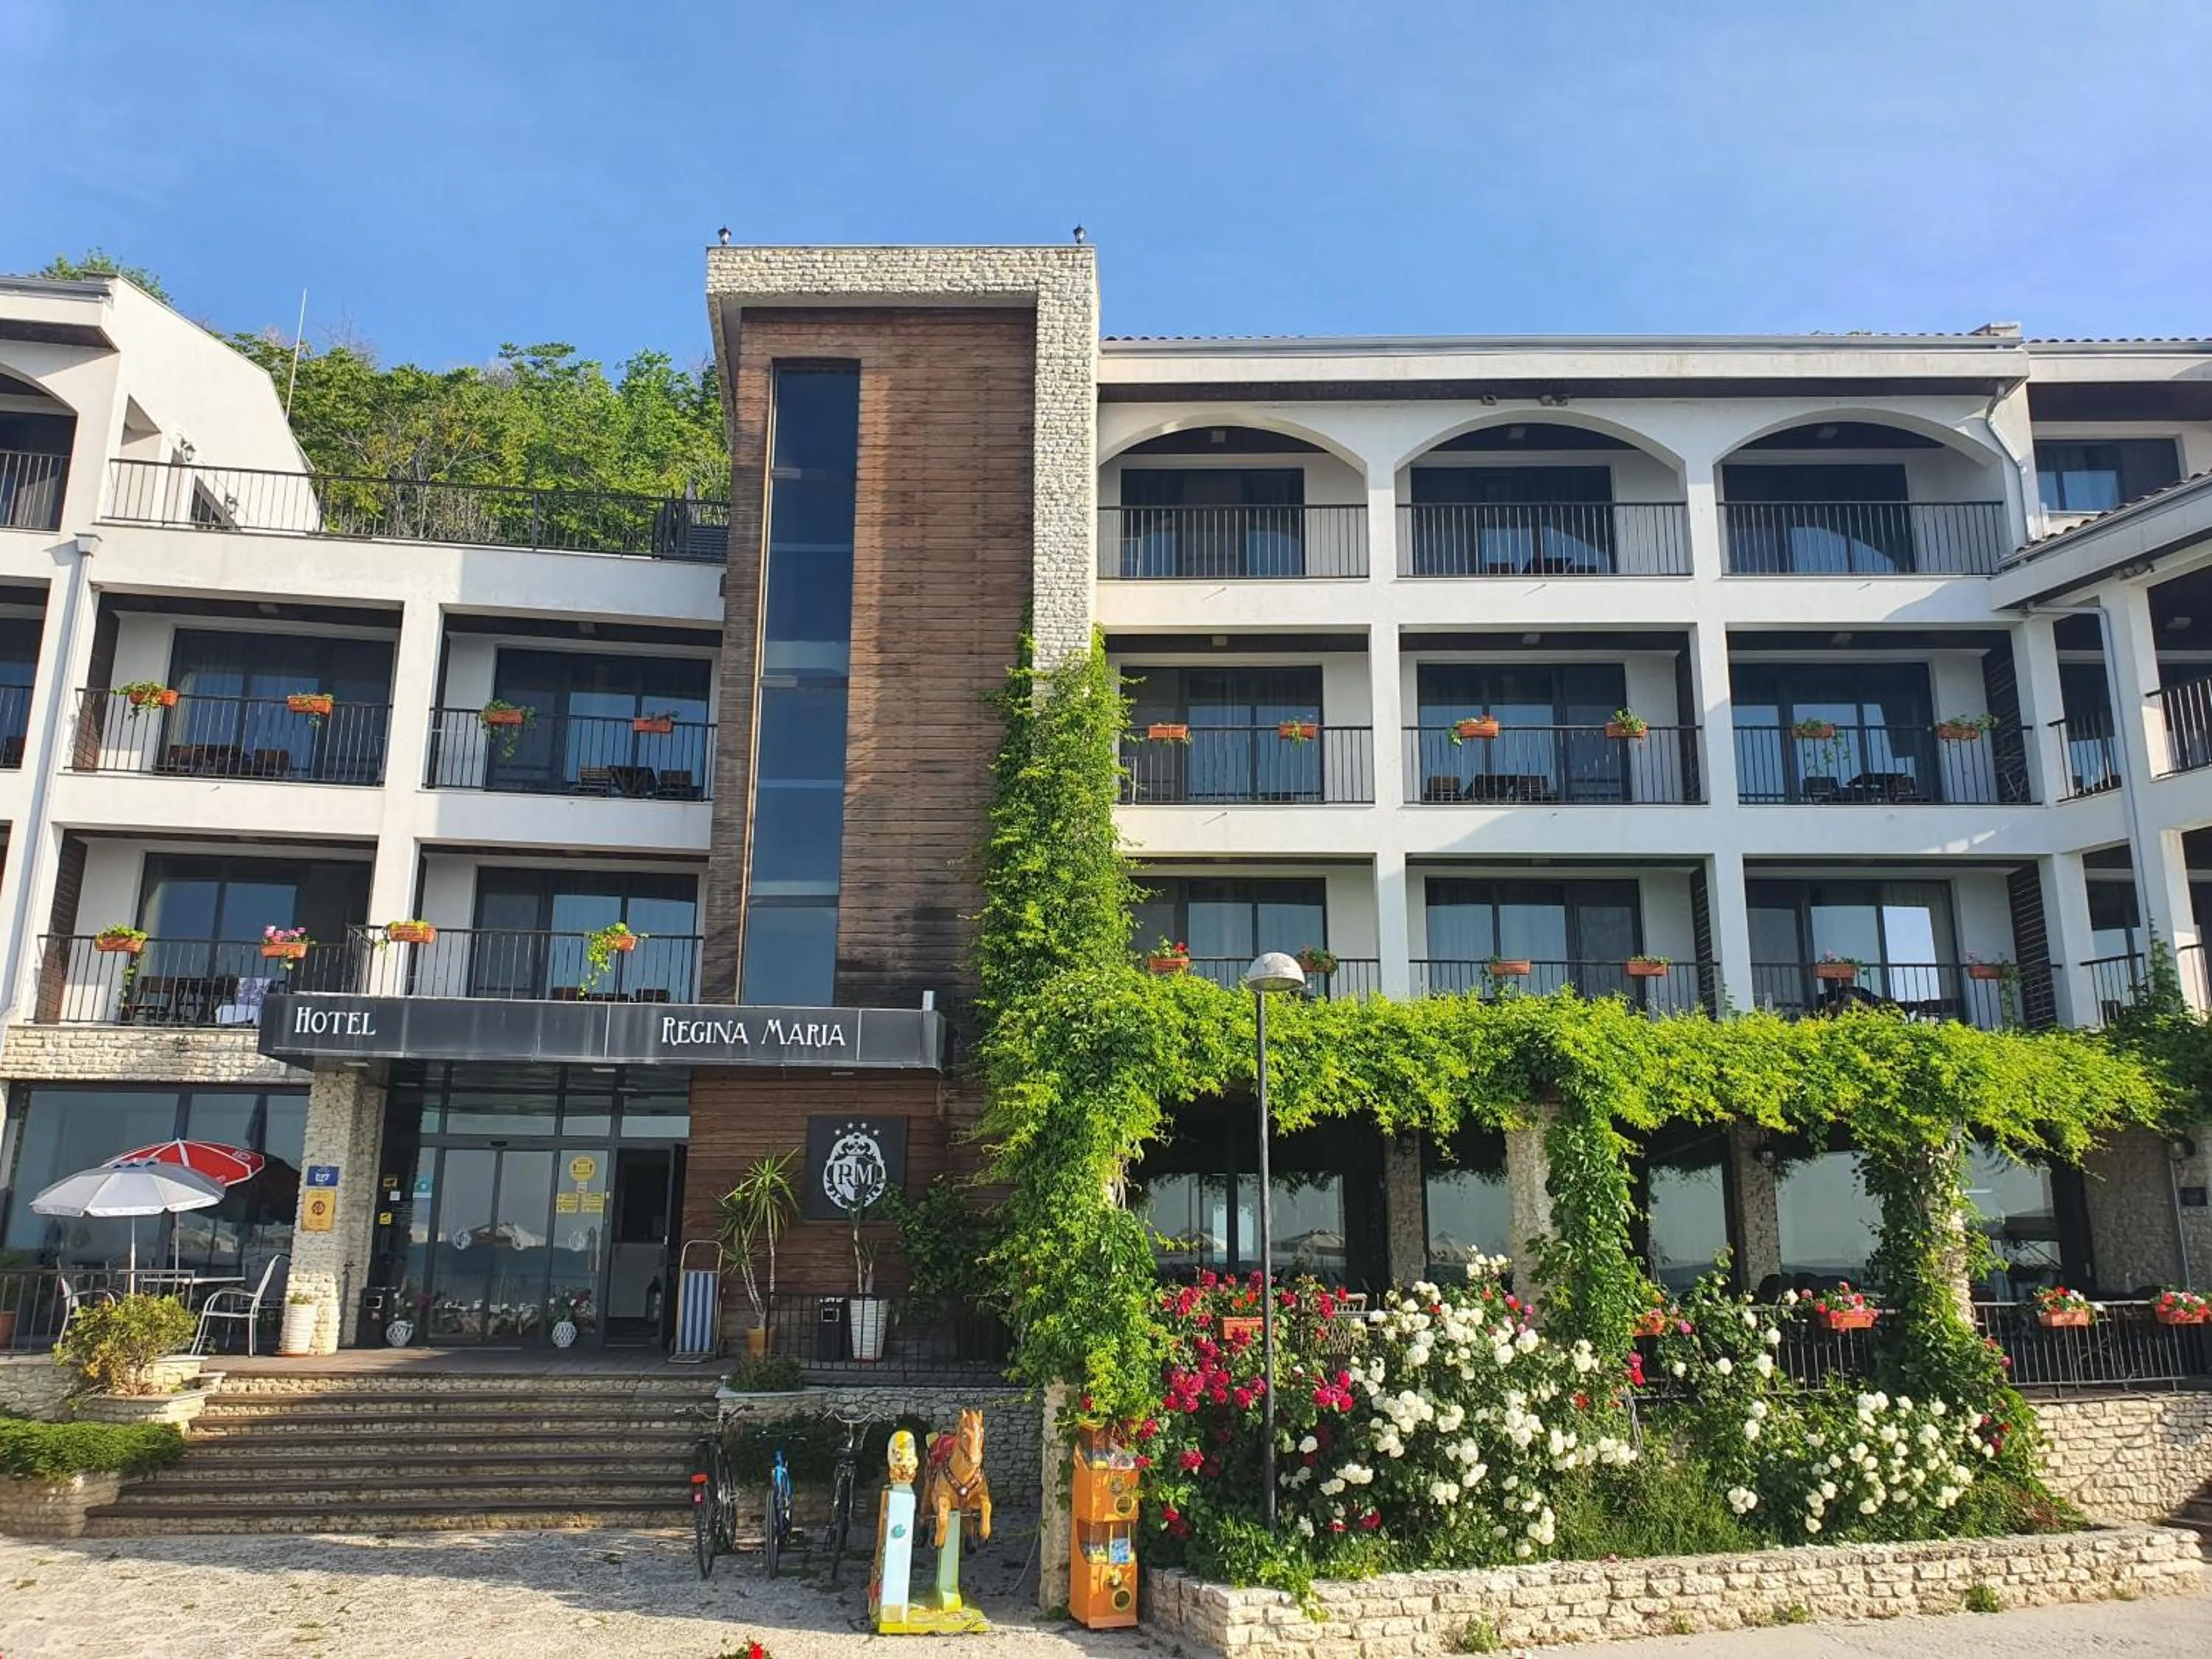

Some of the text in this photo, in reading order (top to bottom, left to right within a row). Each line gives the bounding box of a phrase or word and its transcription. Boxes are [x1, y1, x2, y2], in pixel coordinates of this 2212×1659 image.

[294, 1006, 846, 1048] HOTEL REGINA MARIA
[838, 1164, 872, 1188] RM
